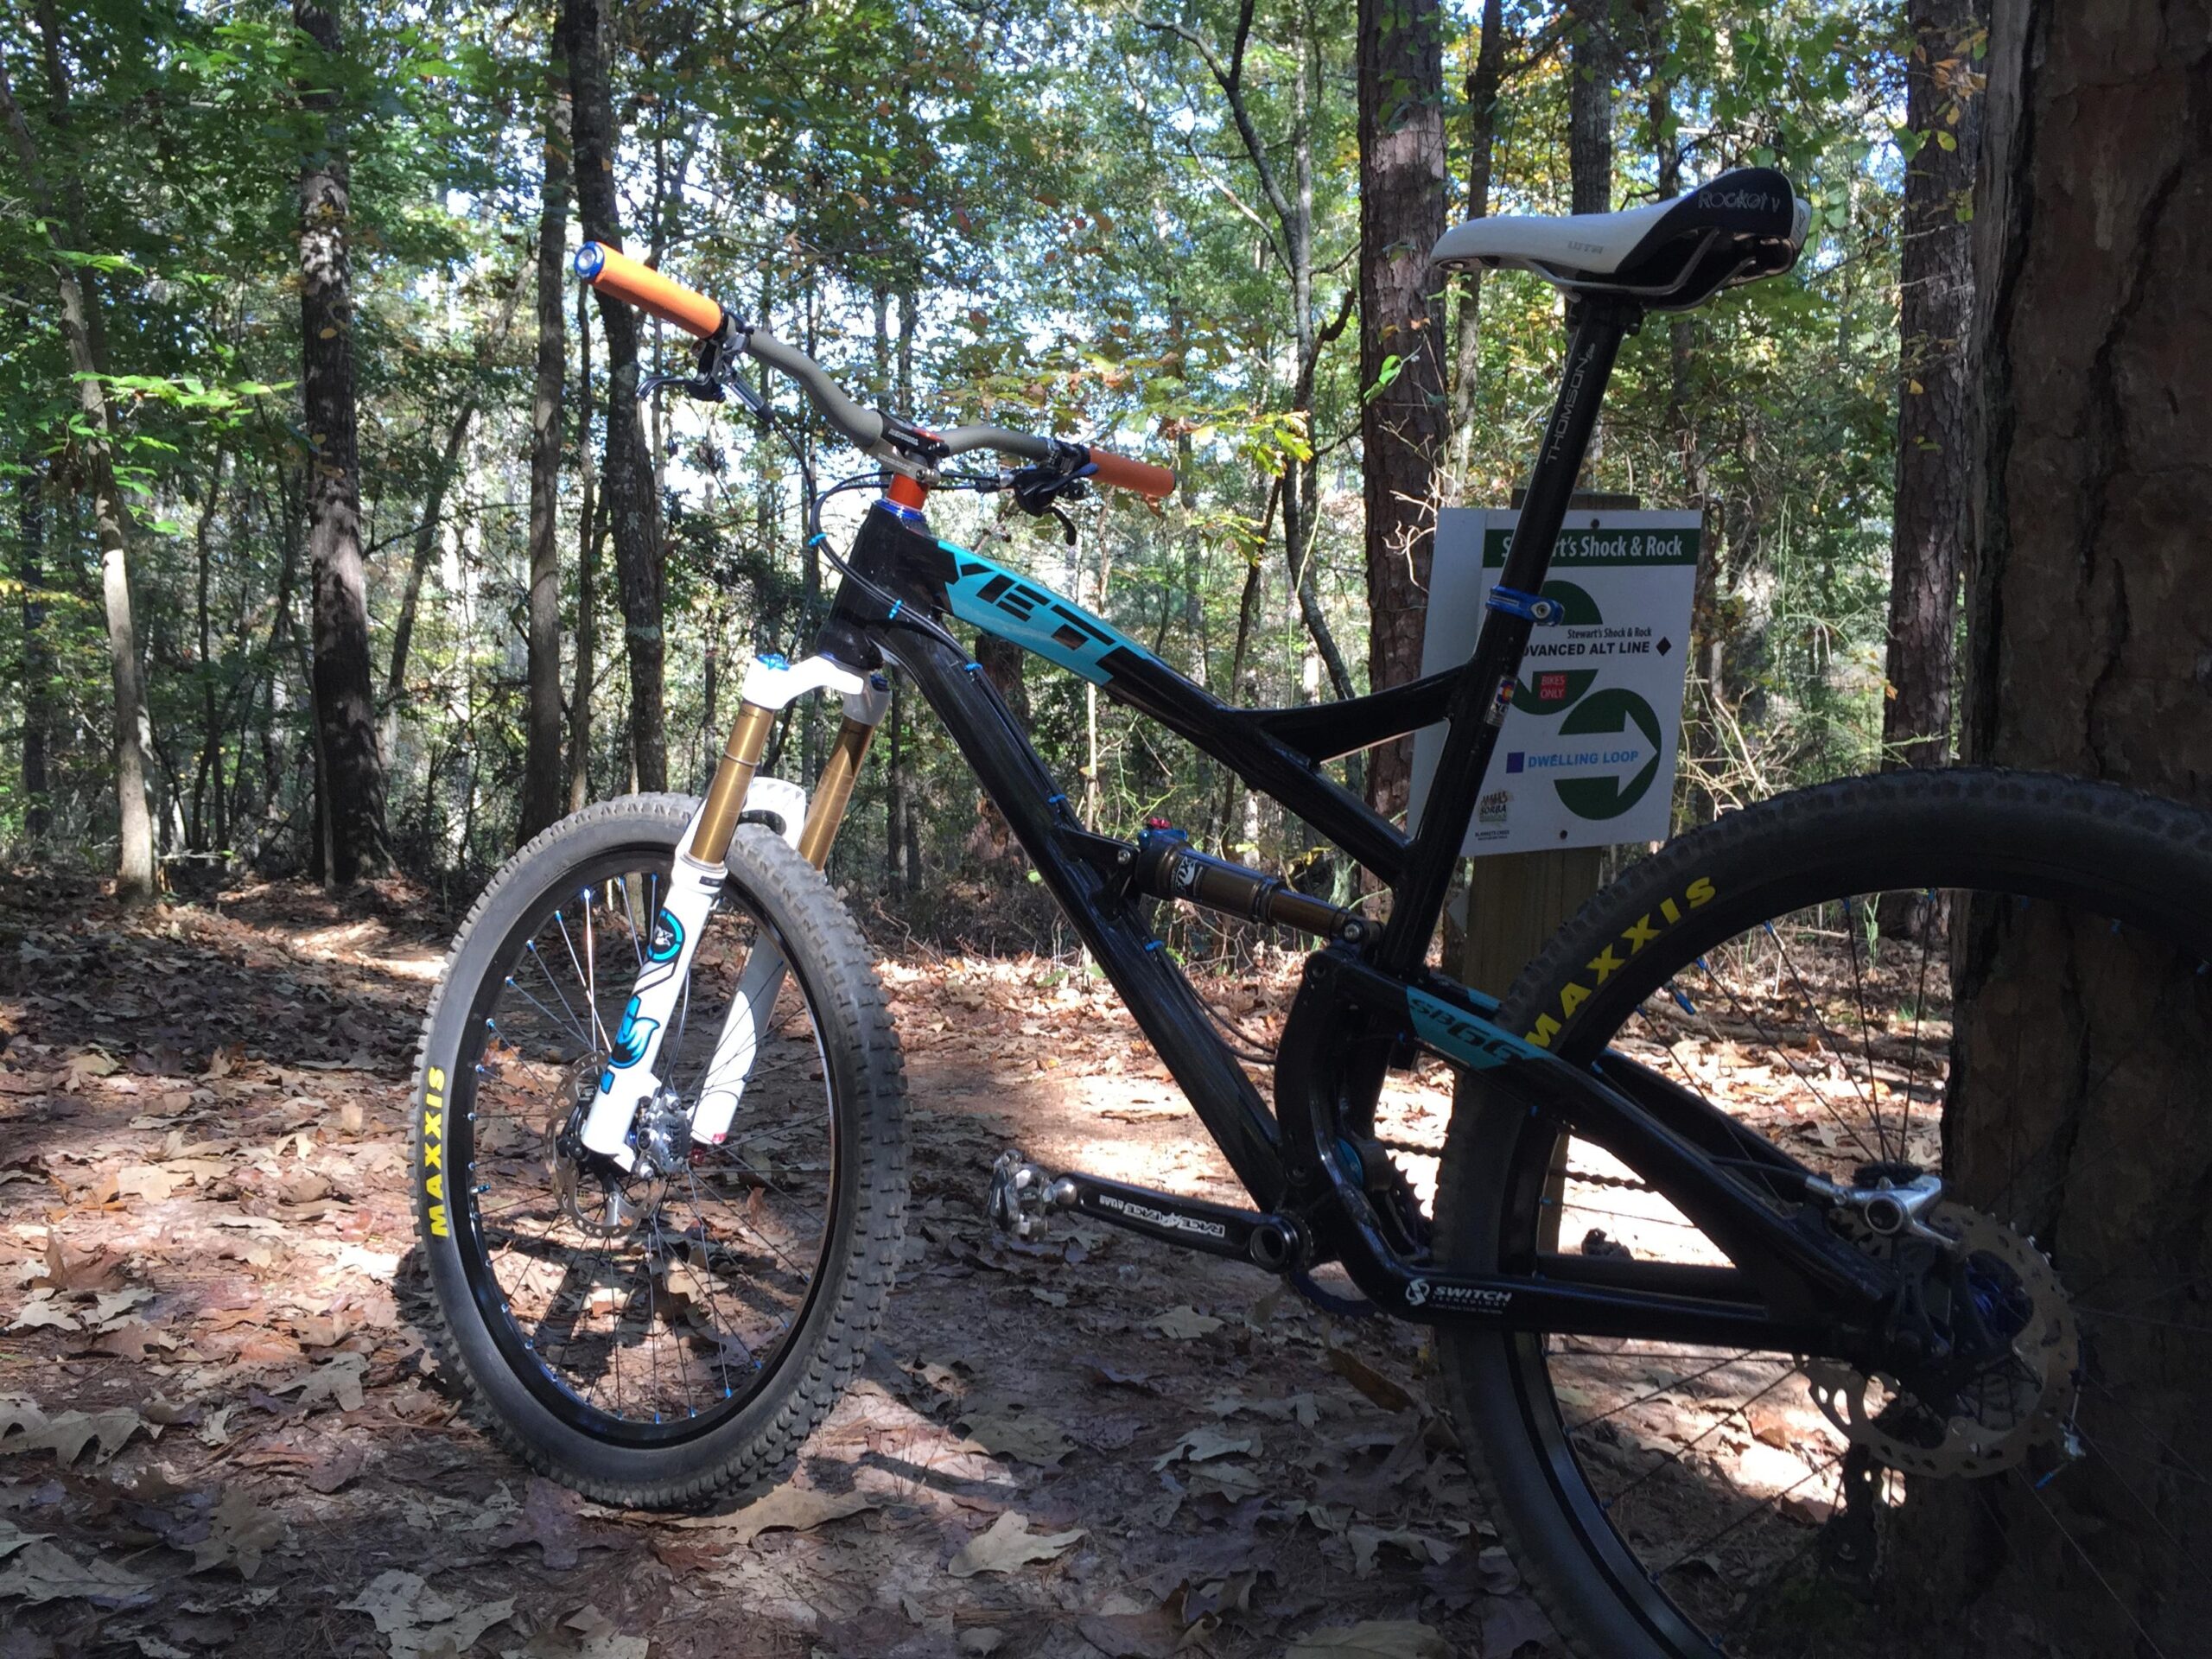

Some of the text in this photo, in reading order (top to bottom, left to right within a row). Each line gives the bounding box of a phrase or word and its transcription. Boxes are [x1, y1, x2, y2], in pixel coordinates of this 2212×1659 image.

[1545, 357, 1588, 464] THOMSON
[1501, 535, 1683, 558] Srt's Shock & Rock
[1567, 626, 1652, 639] Stewart's Shock & Rock
[1522, 641, 1650, 658] DVANCED ALT LINE
[1541, 676, 1566, 686] BIKES
[1540, 689, 1565, 699] ONLY
[1528, 750, 1639, 768] DWELLING LOOP
[1524, 876, 1717, 1048] MAXXIS
[425, 1066, 449, 1237] MAXXIS
[1434, 1285, 1512, 1302] SWITCH
